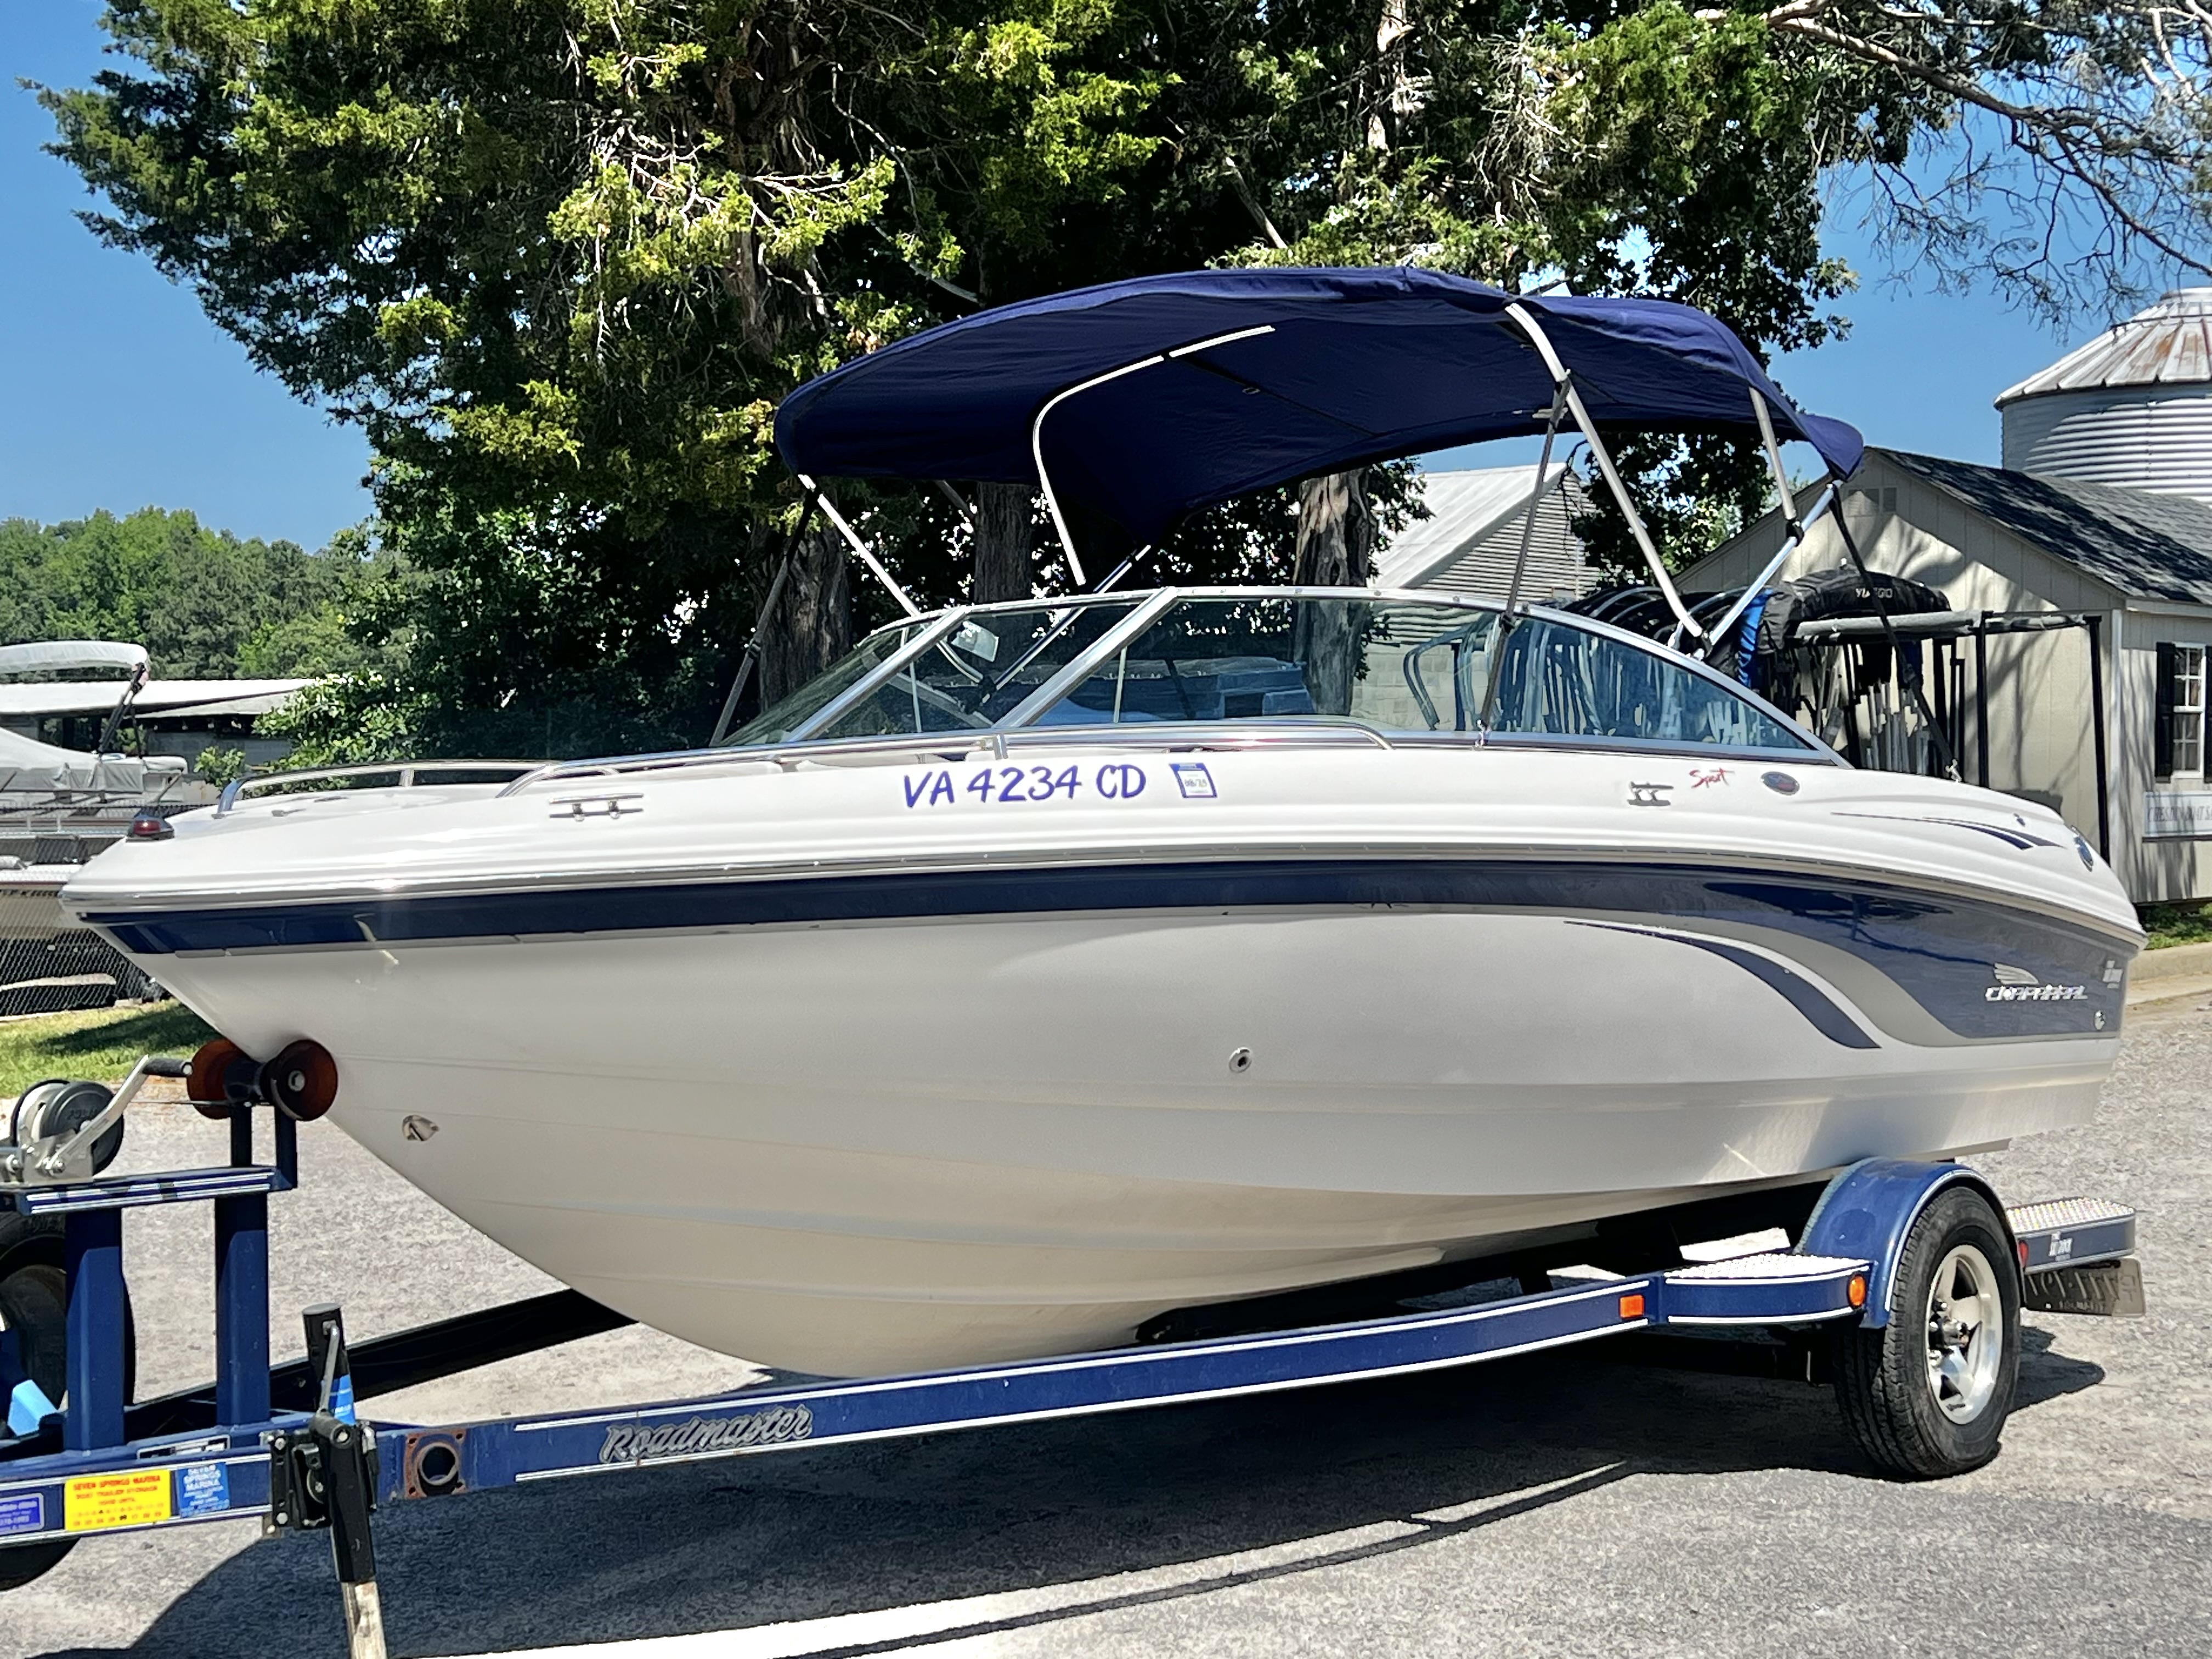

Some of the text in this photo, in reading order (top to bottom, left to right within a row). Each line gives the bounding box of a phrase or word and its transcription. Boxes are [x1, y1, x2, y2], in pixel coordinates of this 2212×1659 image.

[904, 764, 1147, 808] VA 4234 CD
[1689, 768, 1735, 789] Sport
[599, 1404, 813, 1463] Roadmaster
[73, 1475, 161, 1491] SEVEN SPRINGS MARINA
[185, 1479, 221, 1491] MARINA
